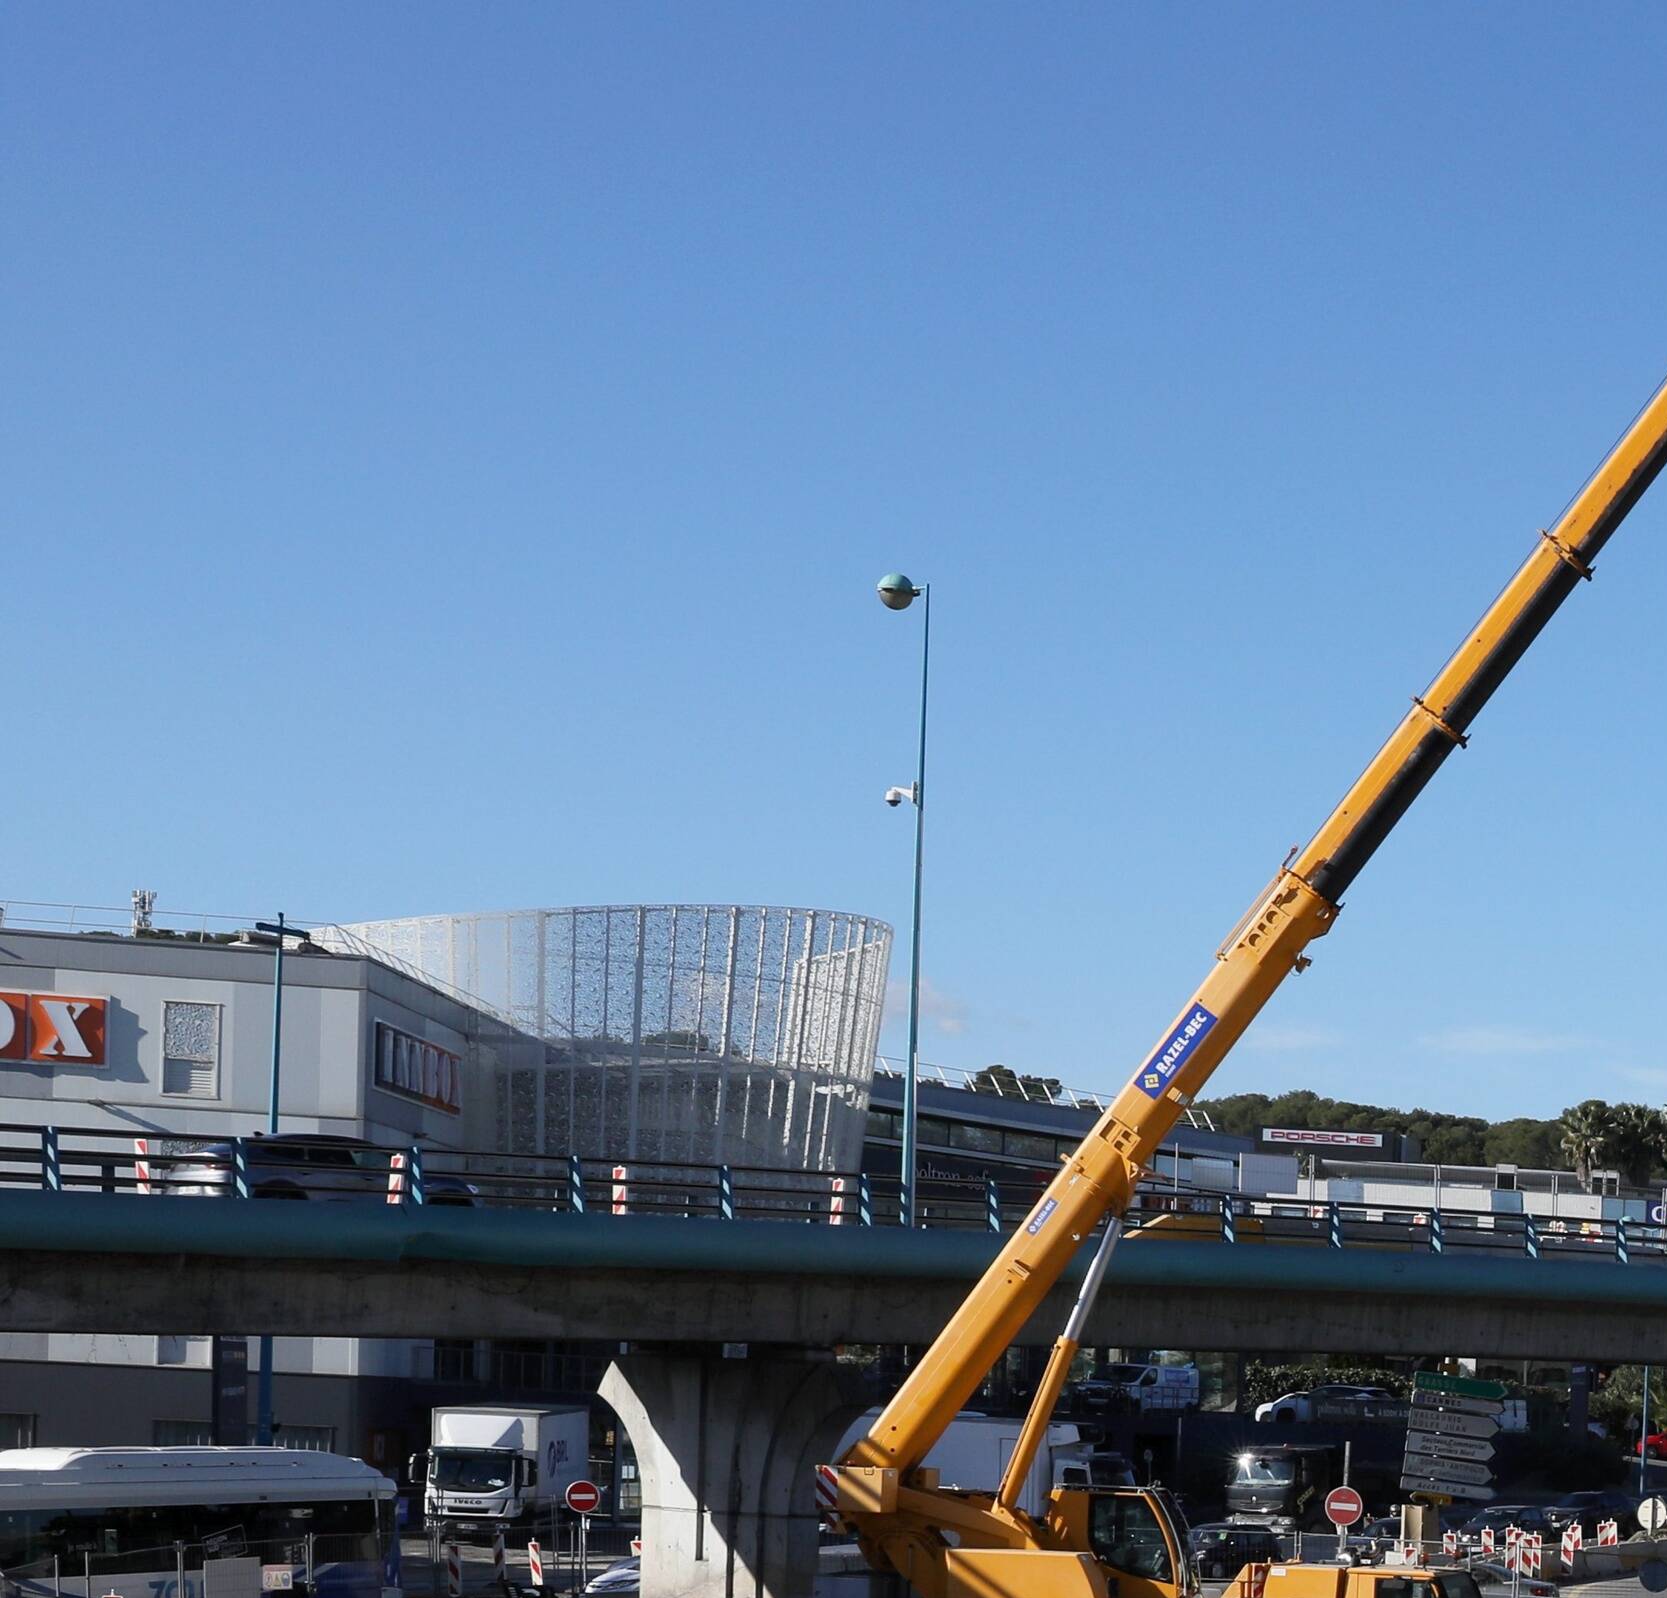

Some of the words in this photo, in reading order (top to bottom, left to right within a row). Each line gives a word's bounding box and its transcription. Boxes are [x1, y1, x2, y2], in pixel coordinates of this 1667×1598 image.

[1155, 1012, 1208, 1075] RAZEL-BEC
[1271, 1131, 1377, 1145] PORSCHE
[1444, 1424, 1467, 1433] JUAN
